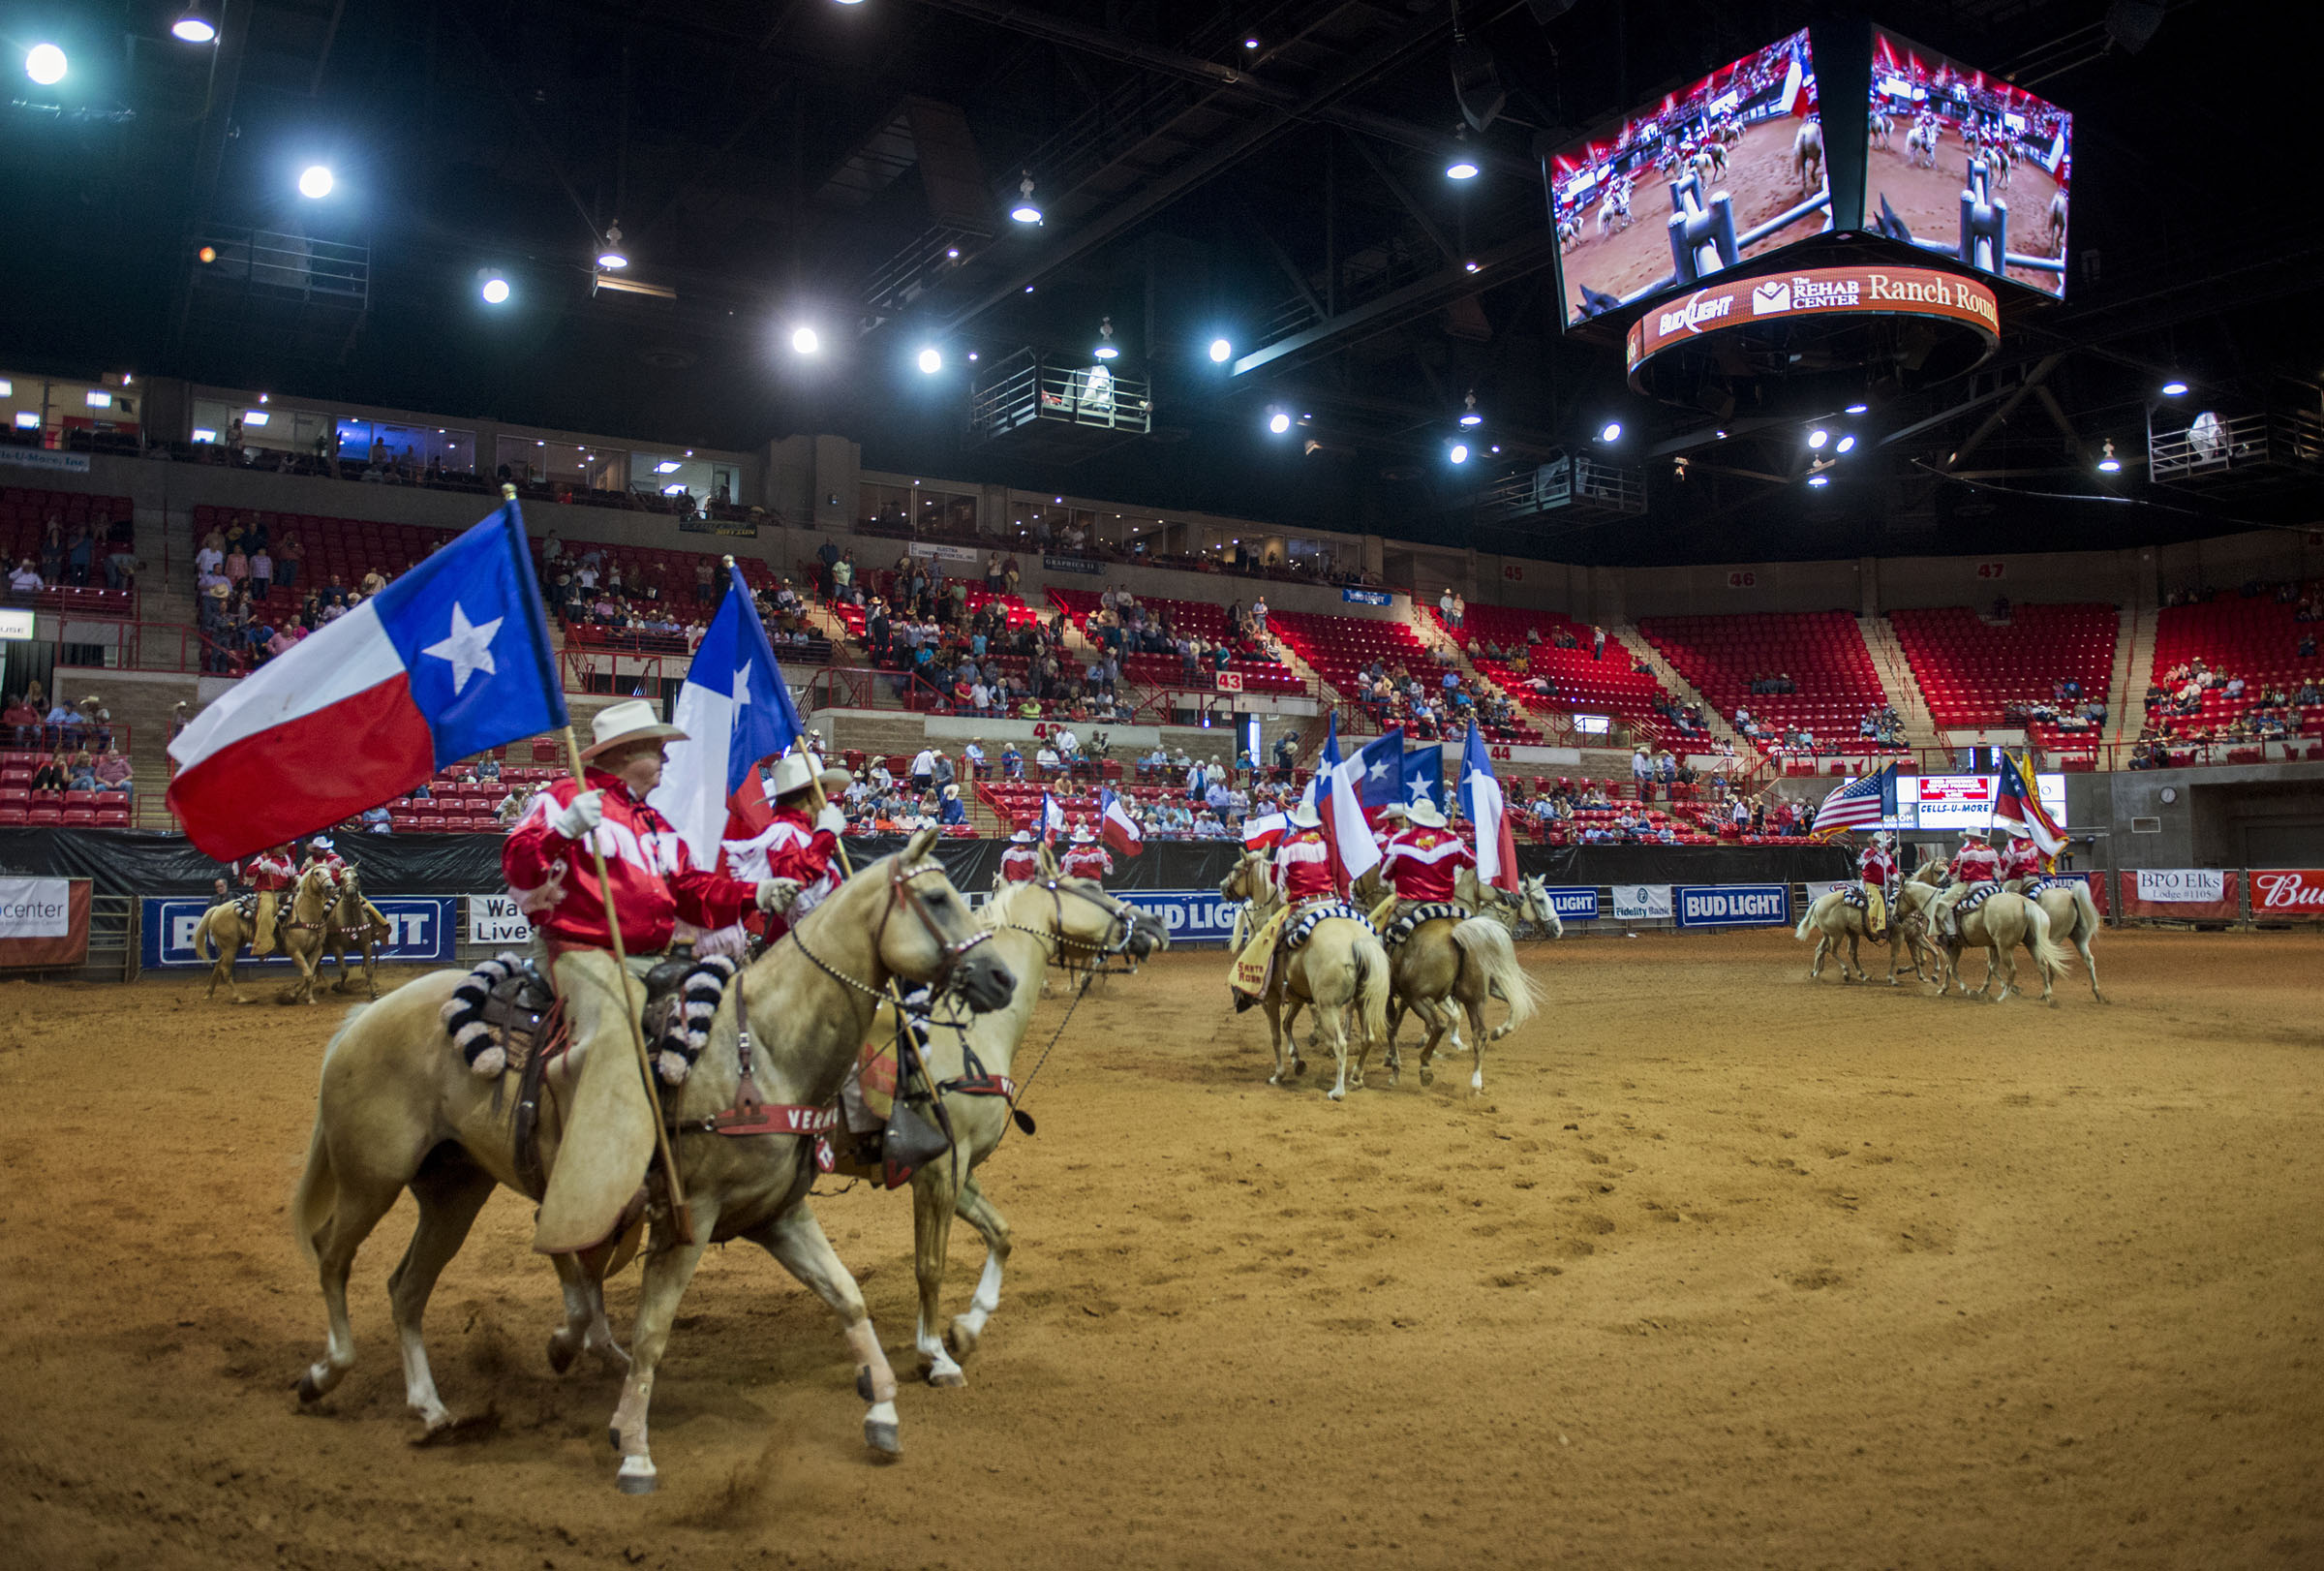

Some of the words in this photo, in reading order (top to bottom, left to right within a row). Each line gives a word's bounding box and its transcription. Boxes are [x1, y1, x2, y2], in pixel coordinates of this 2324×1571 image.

[1792, 277, 1810, 287] The
[1792, 280, 1859, 298] REHAB
[1868, 274, 1950, 306] Ranch
[1792, 293, 1859, 309] CENTER
[1659, 310, 1687, 336] BUD
[1691, 294, 1733, 322] LIGHT
[1504, 567, 1522, 581] 45
[1977, 564, 2003, 578] 47
[1729, 572, 1755, 587] 46
[1218, 673, 1240, 689] 43
[1490, 745, 1511, 760] 44
[1920, 804, 1989, 813] CELLS-U-MORE
[2141, 874, 2179, 888] BPO
[2186, 874, 2220, 888] Elks
[2153, 889, 2181, 900] Lodge
[2184, 889, 2212, 900] #1105
[0, 902, 63, 918] center
[487, 899, 527, 917] Wa
[1556, 896, 1595, 912] LIGHT
[1616, 907, 1646, 917] Fidelity
[1648, 906, 1669, 915] Bank
[1686, 896, 1728, 917] BUD
[1728, 895, 1782, 915] LIGHT
